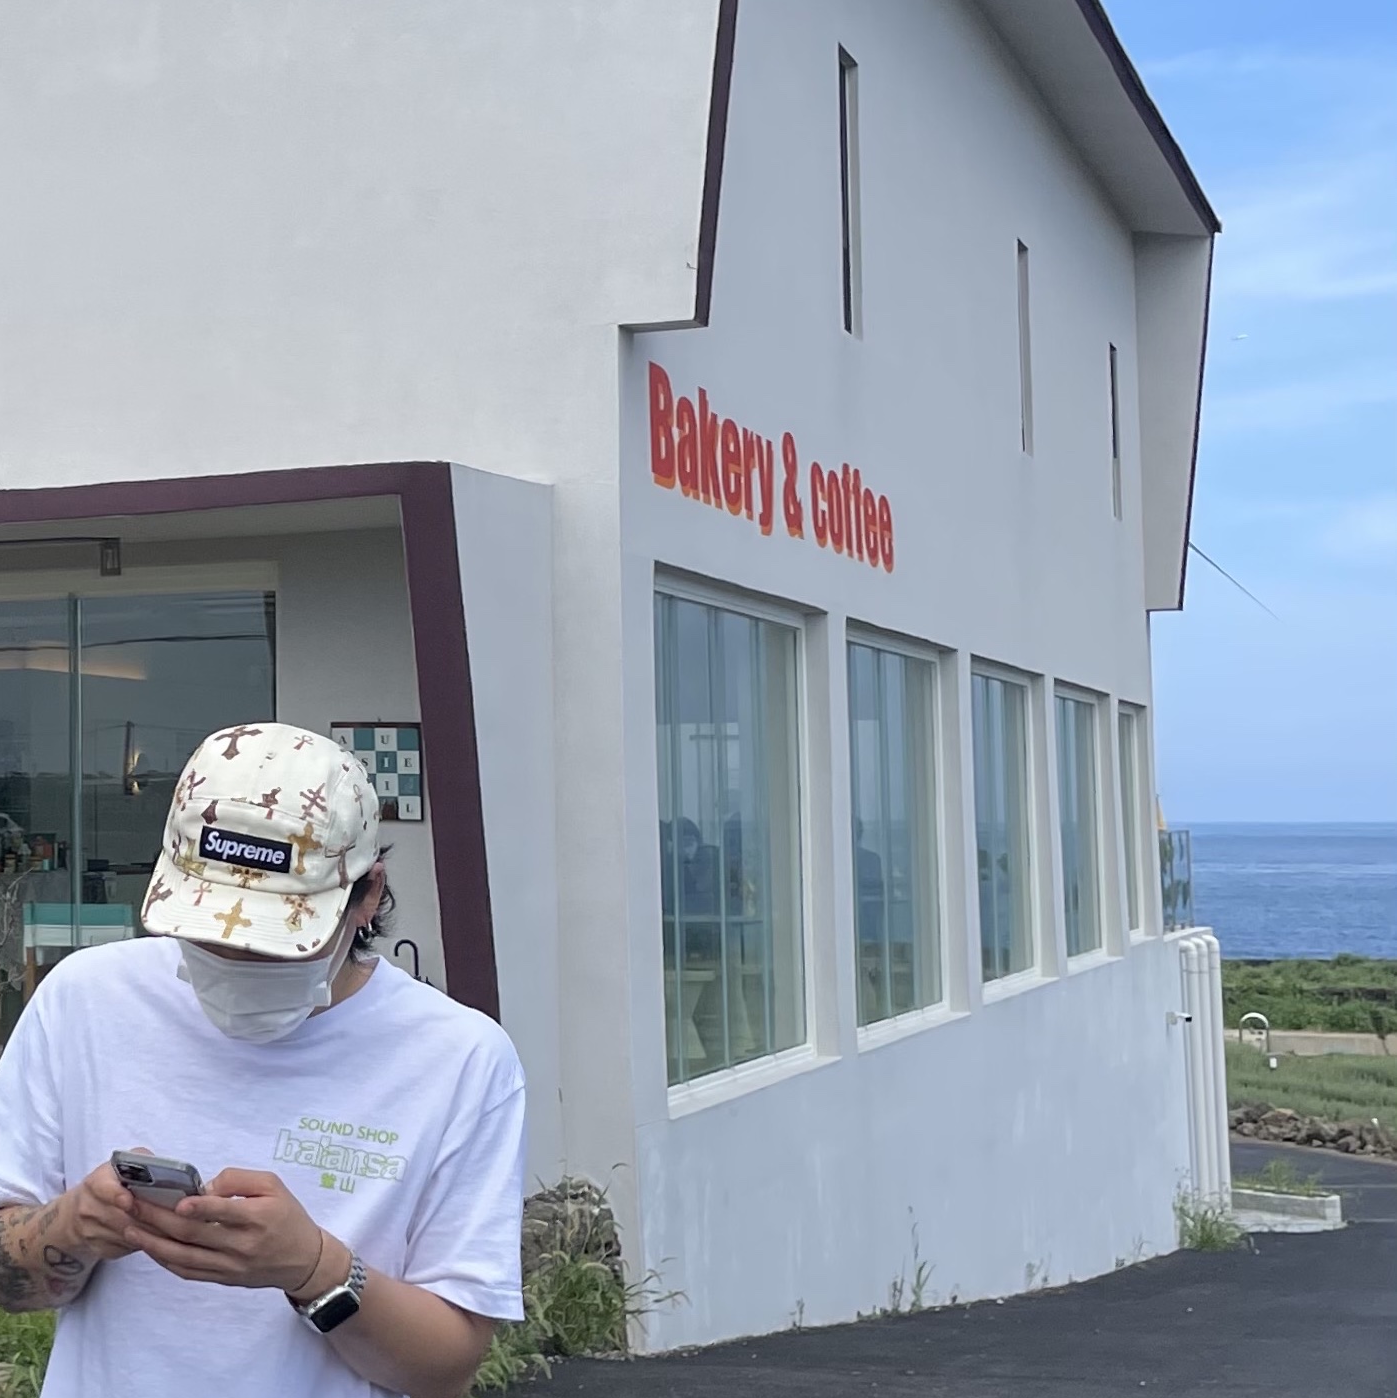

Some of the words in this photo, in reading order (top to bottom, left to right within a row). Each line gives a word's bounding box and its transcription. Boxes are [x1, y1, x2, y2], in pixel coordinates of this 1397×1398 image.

[648, 361, 775, 536] Bakery
[781, 431, 805, 540] &
[809, 461, 895, 573] coffee
[205, 831, 286, 865] Supreme
[298, 1117, 354, 1136] SOUND
[357, 1126, 399, 1146] SHOP
[273, 1128, 409, 1182] balansa
